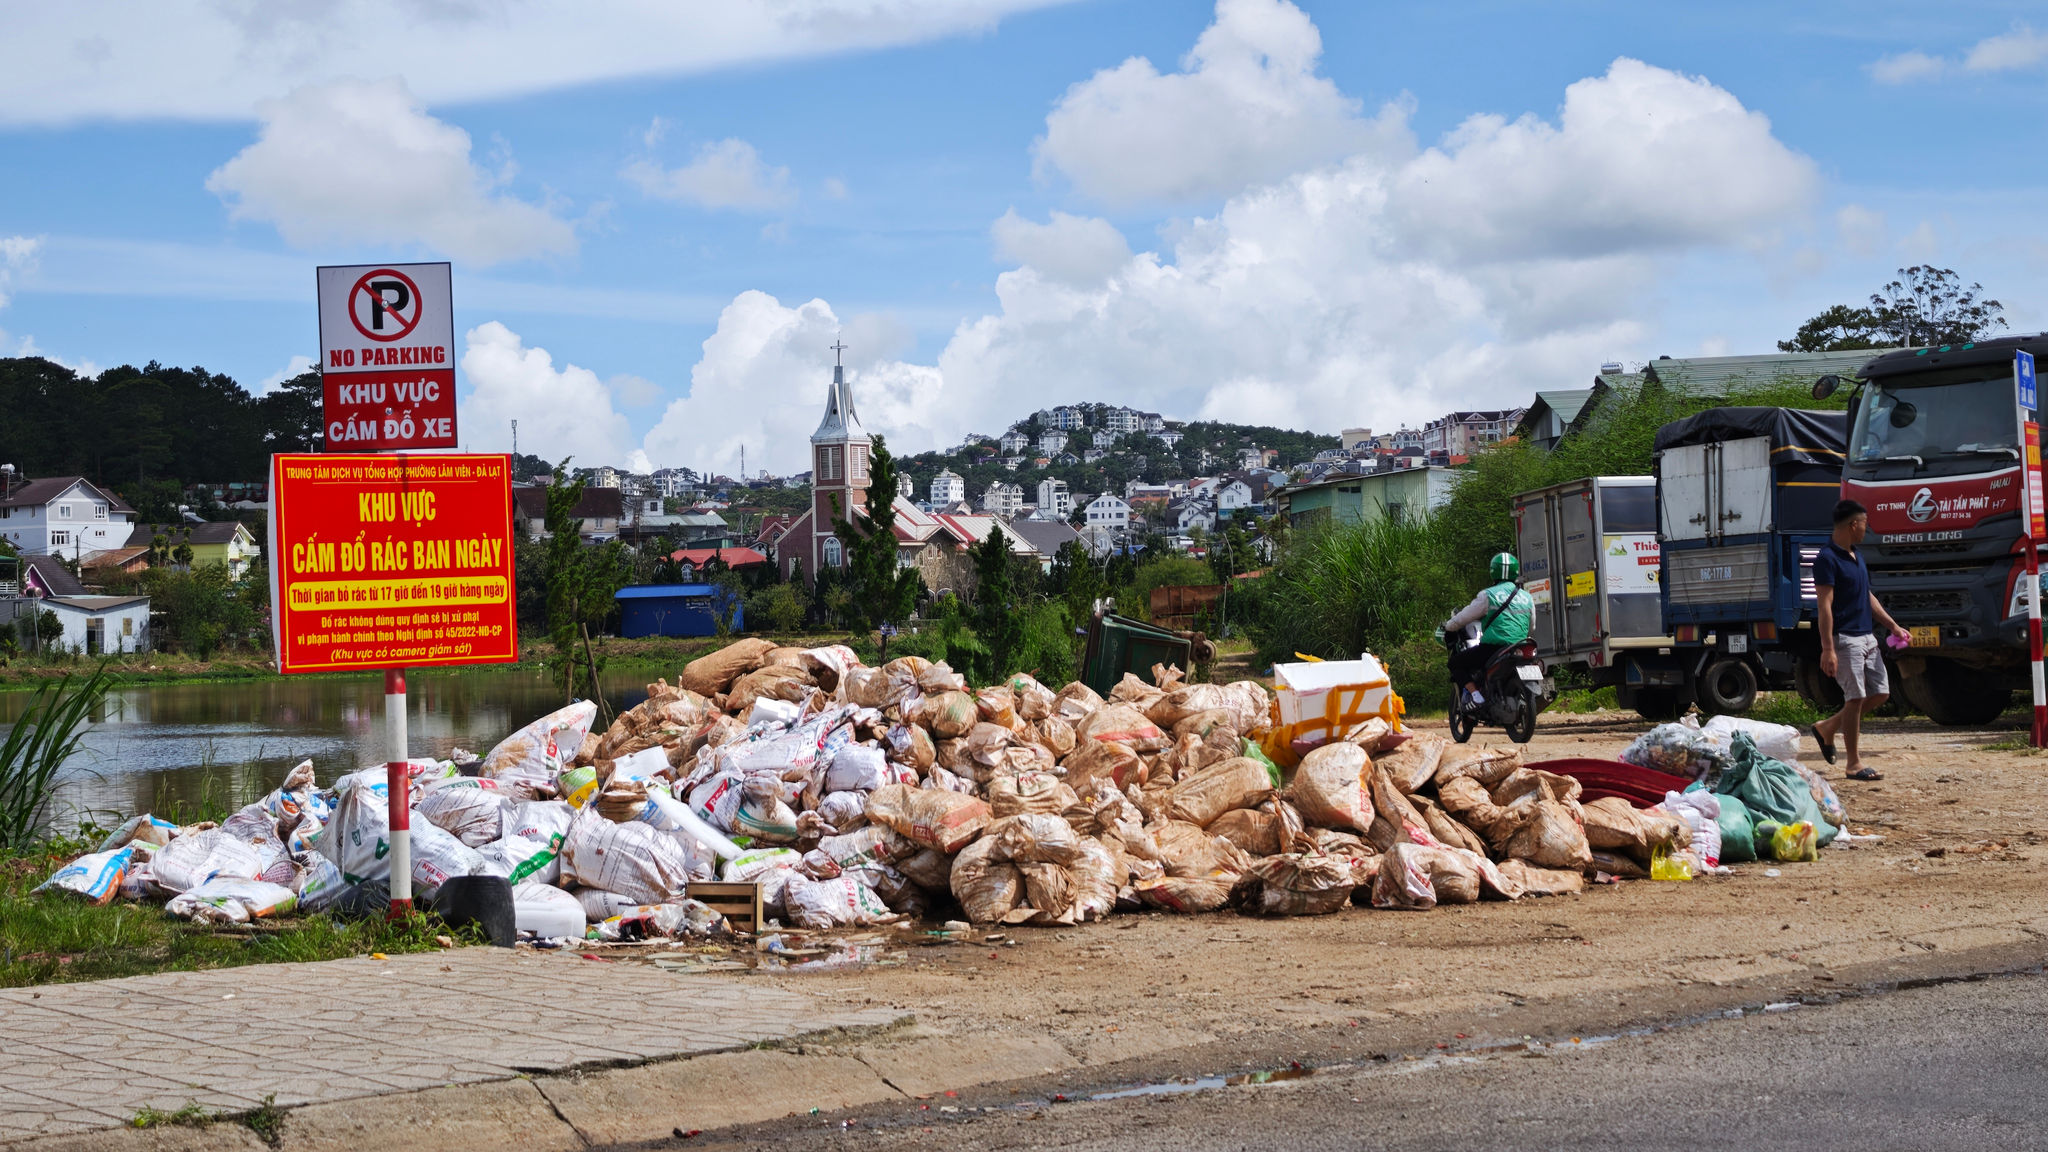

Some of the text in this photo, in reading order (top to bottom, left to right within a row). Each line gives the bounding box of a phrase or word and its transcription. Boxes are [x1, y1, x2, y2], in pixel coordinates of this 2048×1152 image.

[330, 346, 445, 367] NO PARKING
[339, 378, 440, 408] KHU VỰC
[329, 409, 452, 442] CẤM ĐỖ XE
[286, 467, 312, 479] TRUNG
[314, 464, 330, 479] TÂM
[332, 467, 350, 482] DỊCH
[352, 467, 362, 482] VỤ
[364, 461, 386, 479] TỔNG
[387, 465, 404, 482] HỢP
[405, 464, 436, 478] PHƯỜNG
[438, 463, 454, 477] LÂM
[455, 463, 471, 477] VIÊN
[476, 463, 488, 477] ĐÀ
[488, 466, 500, 480] LẠT
[359, 489, 436, 527] KHU VỰC
[1890, 502, 1906, 510] TNHH
[1940, 497, 1951, 512] TÀI
[1969, 494, 1990, 510] PHÁT
[1882, 530, 1963, 544] CHENG LONG
[293, 530, 502, 574] CẤM ĐỔ RÁC BAN NGÀY
[292, 581, 504, 605] Thời gian bỏ rác từ 17 giờ đến 19 giờ hàng ngày
[334, 615, 348, 628] rác
[349, 615, 374, 628] không
[375, 614, 395, 627] đúng
[396, 615, 410, 626] quy
[412, 612, 430, 626] định
[442, 611, 450, 625] bị
[452, 610, 462, 622] xử
[462, 610, 480, 624] phạt
[298, 633, 305, 646] vi
[306, 632, 330, 647] phạm
[332, 632, 351, 644] hành
[353, 630, 375, 643] chính
[376, 630, 394, 642] theo
[396, 628, 414, 643] Nghị
[416, 628, 433, 642] định
[434, 626, 444, 639] số
[331, 642, 472, 662] (Khu vực có camera giám sát)
